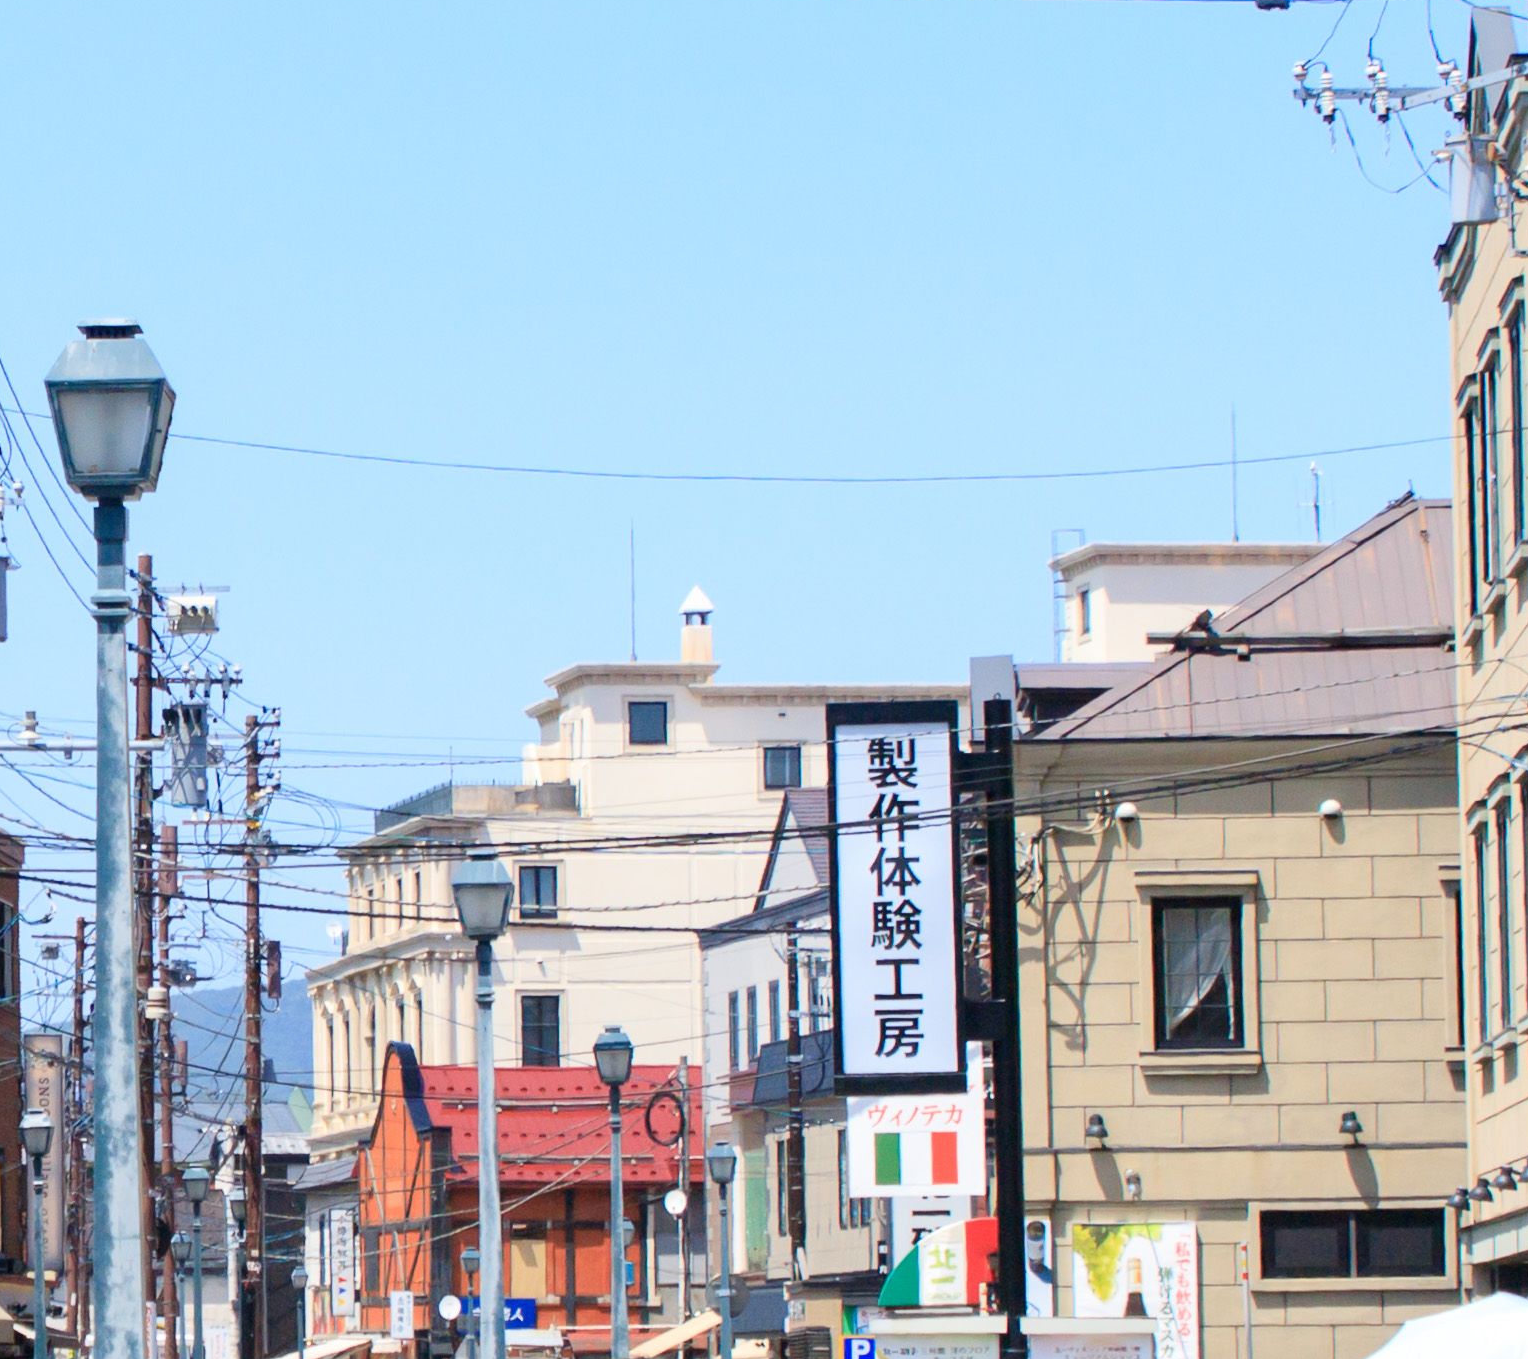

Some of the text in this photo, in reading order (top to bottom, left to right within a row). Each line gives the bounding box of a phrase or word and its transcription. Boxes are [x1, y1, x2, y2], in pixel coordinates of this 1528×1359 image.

[868, 737, 924, 1058] 製作体験工房
[868, 1104, 964, 1128] ヴィノテカ
[928, 1245, 957, 1284] 北一
